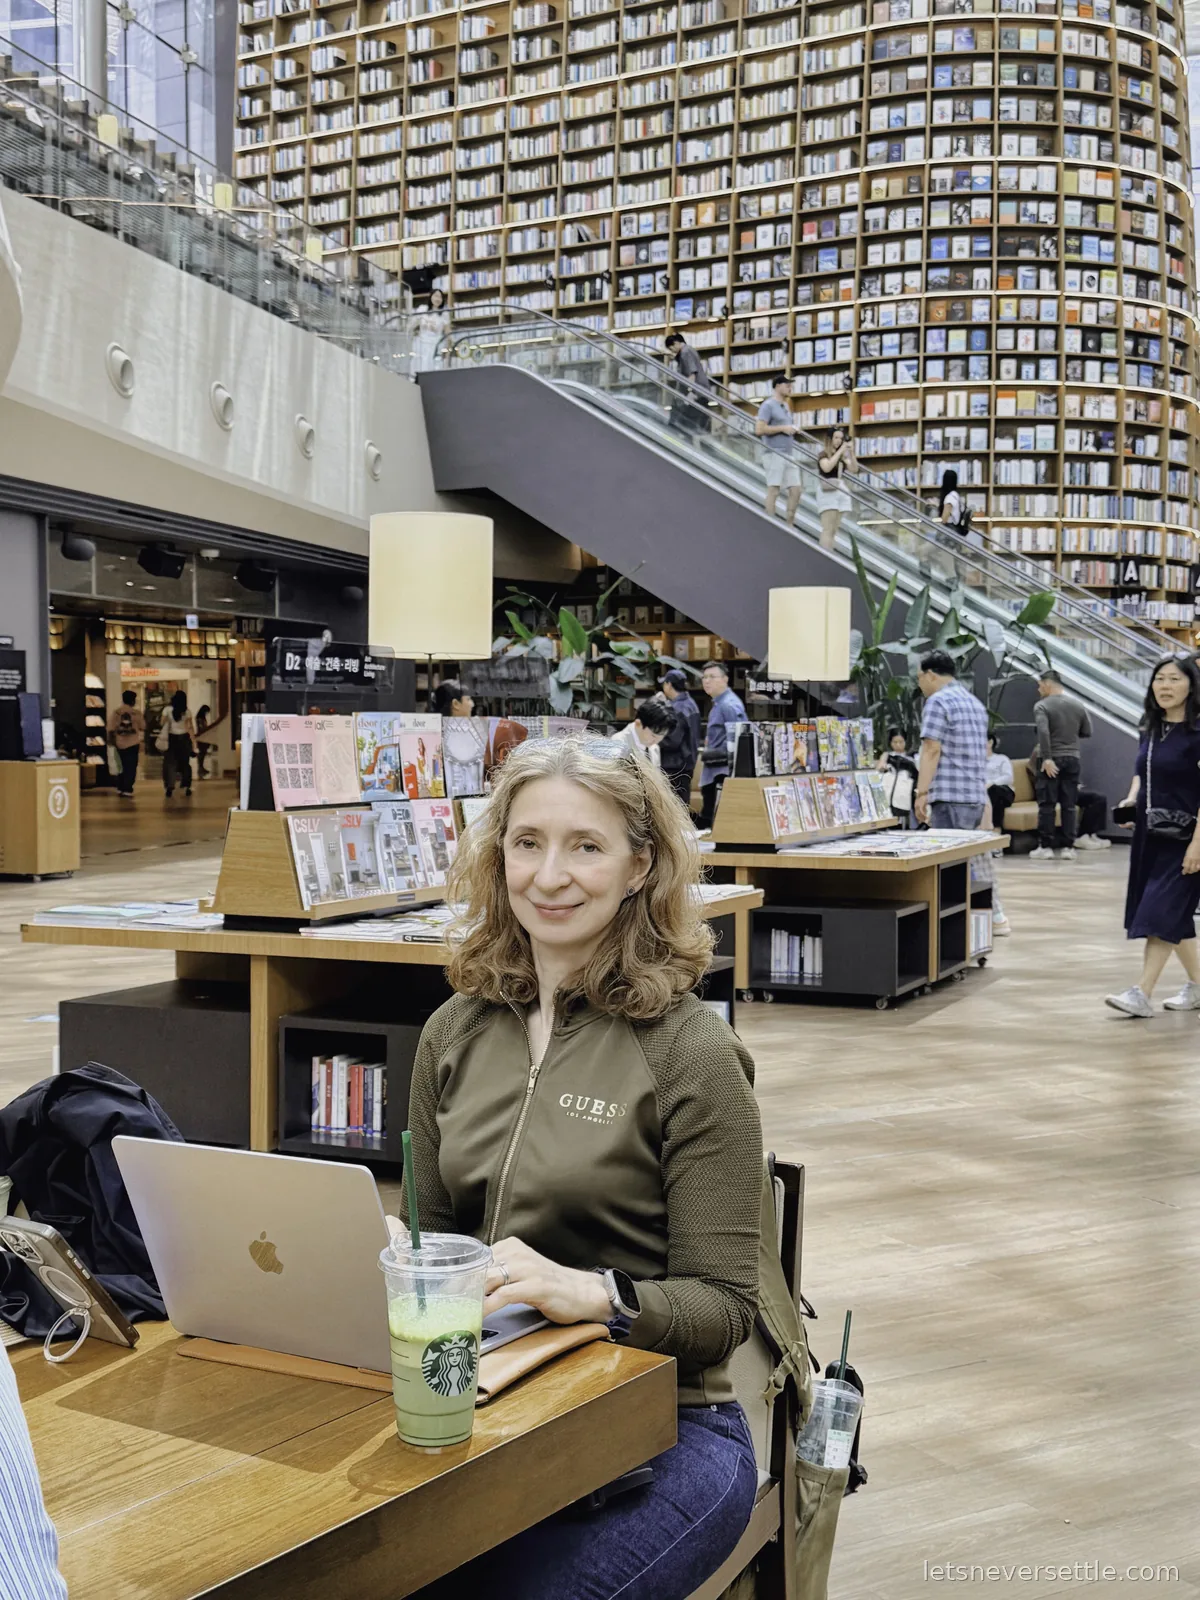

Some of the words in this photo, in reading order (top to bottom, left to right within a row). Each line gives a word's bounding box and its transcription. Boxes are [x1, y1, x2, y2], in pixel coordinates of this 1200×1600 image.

[1124, 560, 1138, 581] A
[285, 652, 300, 671] D2
[358, 717, 377, 728] door
[294, 818, 320, 833] CSLV
[341, 814, 361, 828] SLV
[559, 1093, 627, 1117] GUESS
